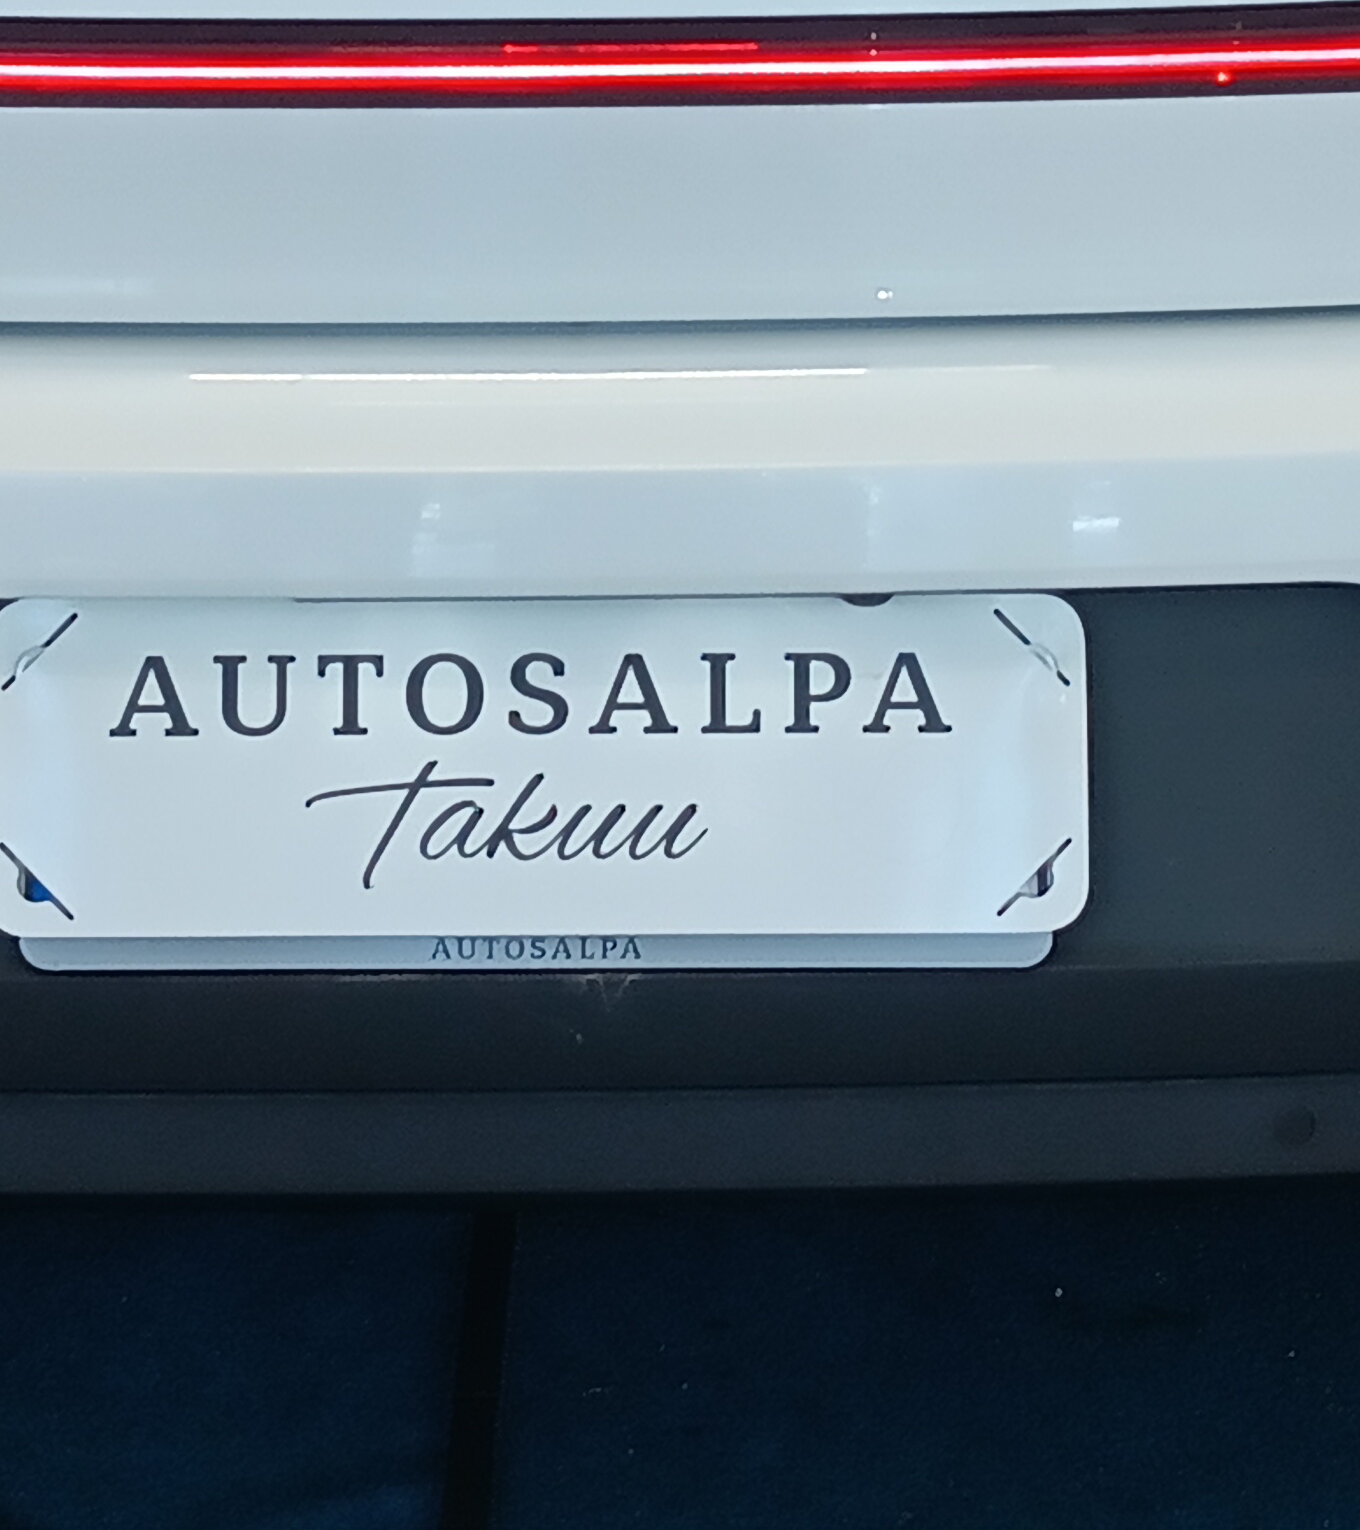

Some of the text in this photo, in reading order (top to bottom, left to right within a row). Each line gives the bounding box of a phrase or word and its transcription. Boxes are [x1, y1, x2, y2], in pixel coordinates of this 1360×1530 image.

[108, 651, 953, 738] AUTOSALPA
[305, 760, 709, 890] Takuu
[428, 935, 642, 961] AUTOSALPA
